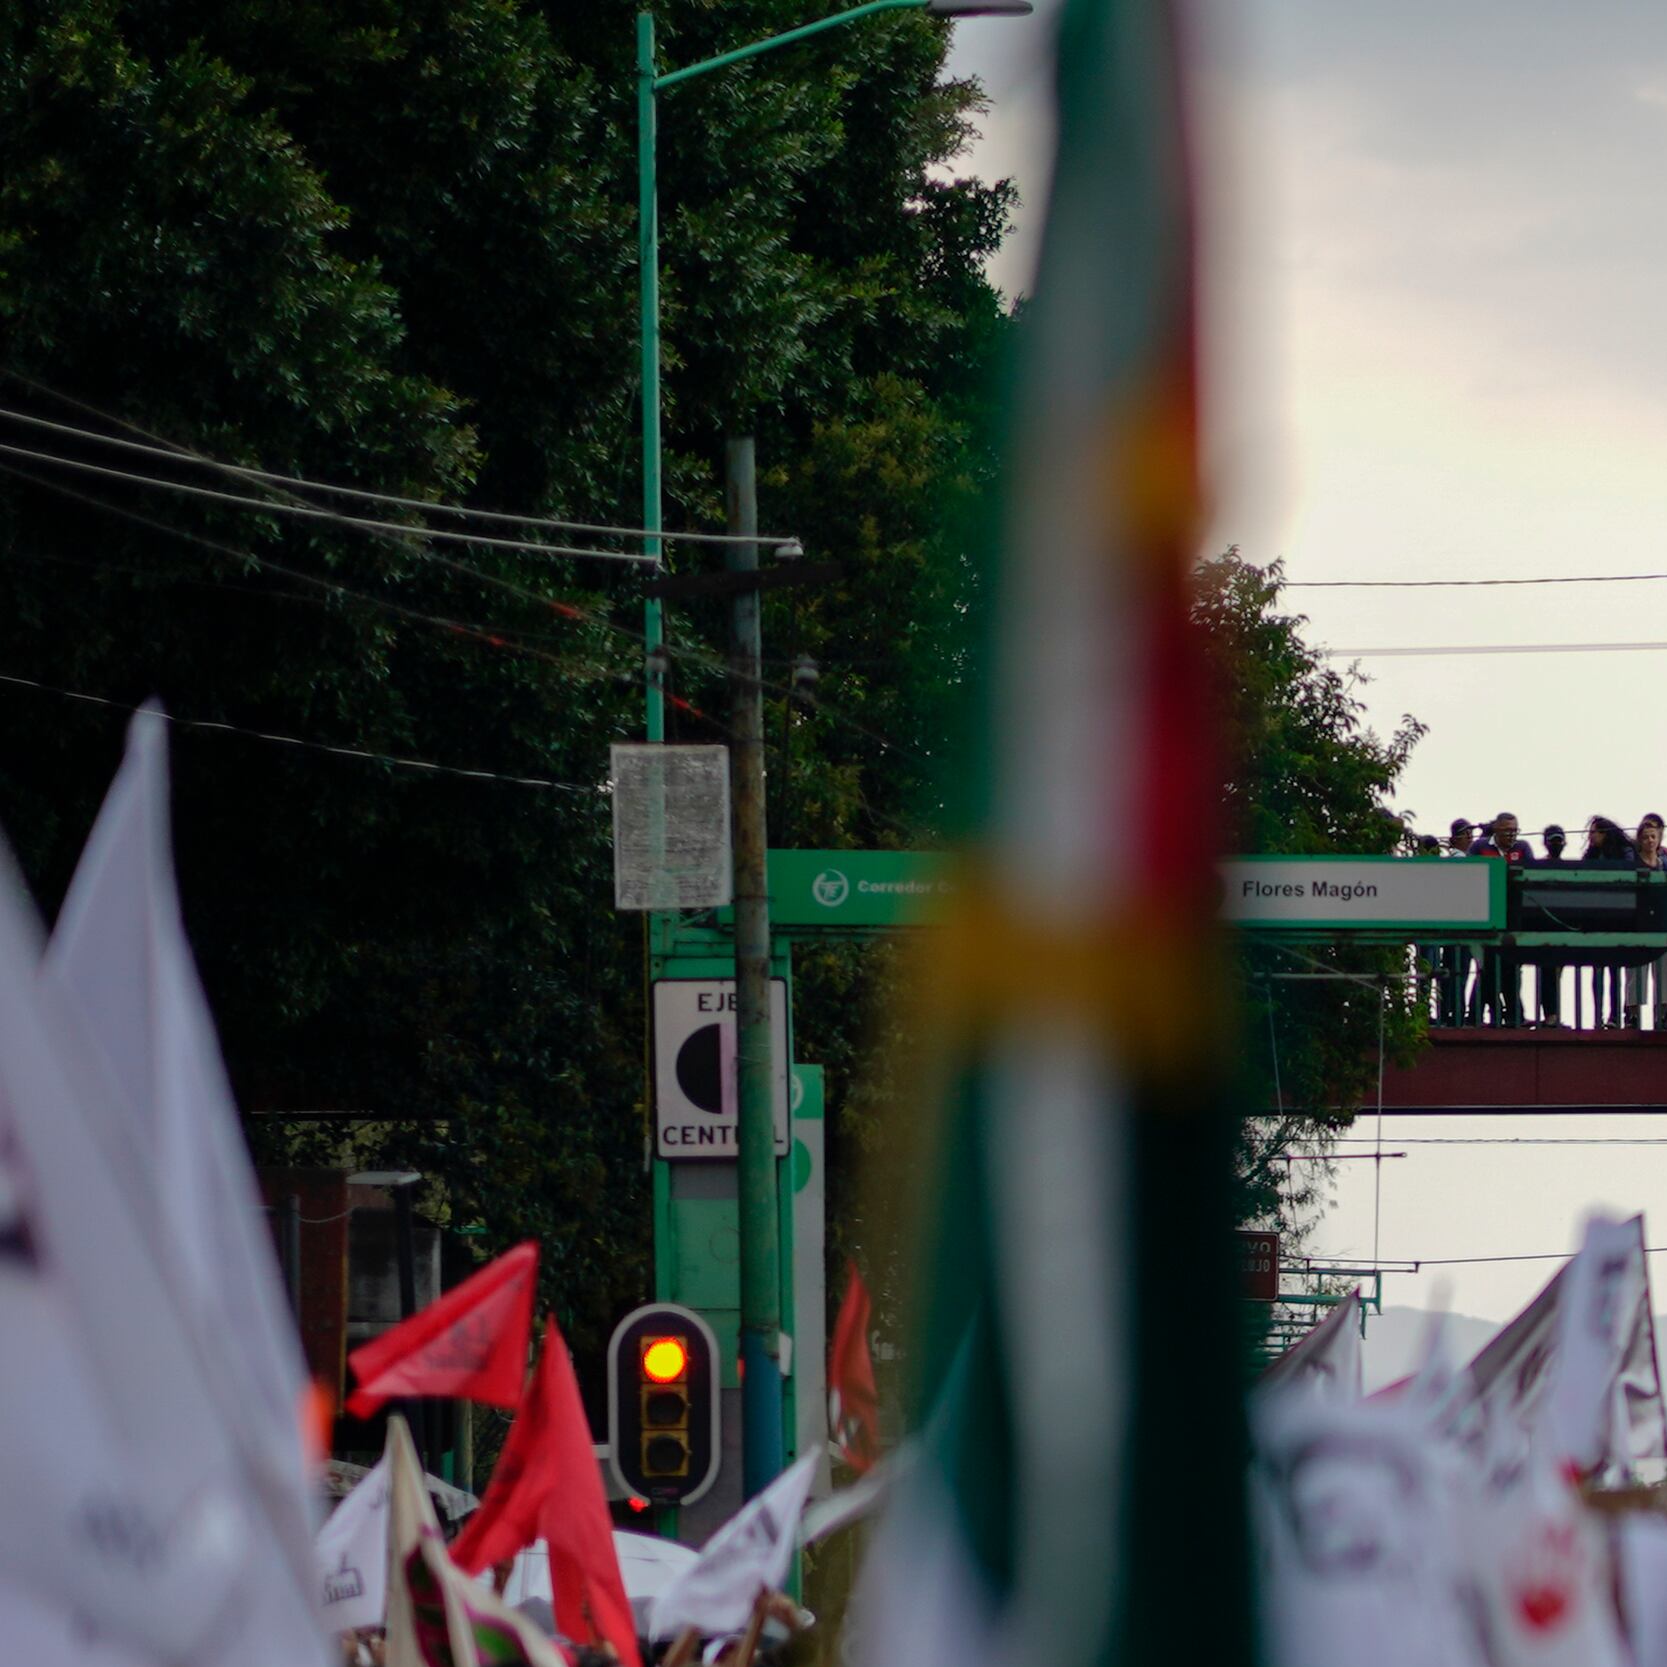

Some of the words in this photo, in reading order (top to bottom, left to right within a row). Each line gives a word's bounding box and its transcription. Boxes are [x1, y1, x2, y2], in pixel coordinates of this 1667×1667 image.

[858, 880, 932, 894] Corredor
[1243, 881, 1305, 898] Flores
[1312, 880, 1378, 901] Magón
[663, 1125, 784, 1145] CENTL
